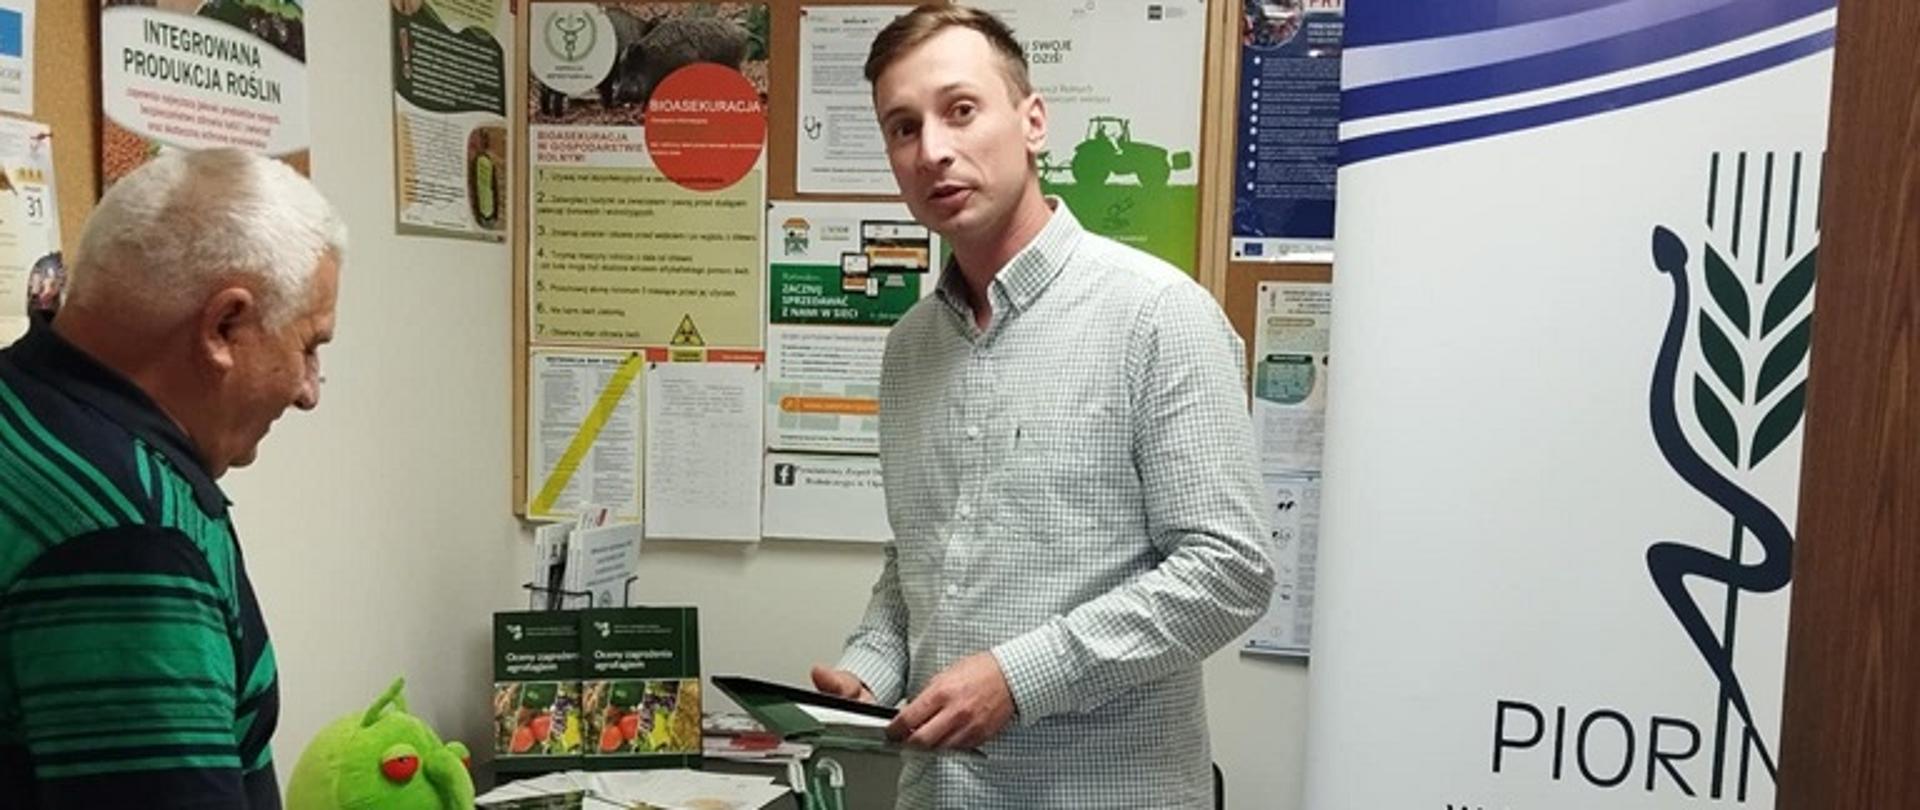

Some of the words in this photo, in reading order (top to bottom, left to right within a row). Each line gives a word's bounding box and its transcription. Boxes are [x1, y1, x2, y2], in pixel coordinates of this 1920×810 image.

[144, 18, 261, 69] INTEGROWANA
[123, 47, 222, 92] PRODUKCJA
[227, 70, 281, 105] ROŚLIN
[649, 99, 761, 113] BIOASEKURACJA
[537, 131, 628, 141] BIOASEKURACJA
[549, 142, 643, 153] GOSPODARSTWIE
[782, 295, 849, 307] SPRZEDAWAĆ
[790, 308, 818, 318] NAMI
[821, 308, 832, 318] W
[834, 308, 860, 319] SIECI
[505, 652, 536, 663] Oceny
[537, 650, 581, 663] zagrożen
[594, 649, 624, 661] Oceny
[624, 649, 674, 661] zagrożenia
[506, 662, 558, 674] agrofagiem
[594, 660, 646, 673] agrofagiem
